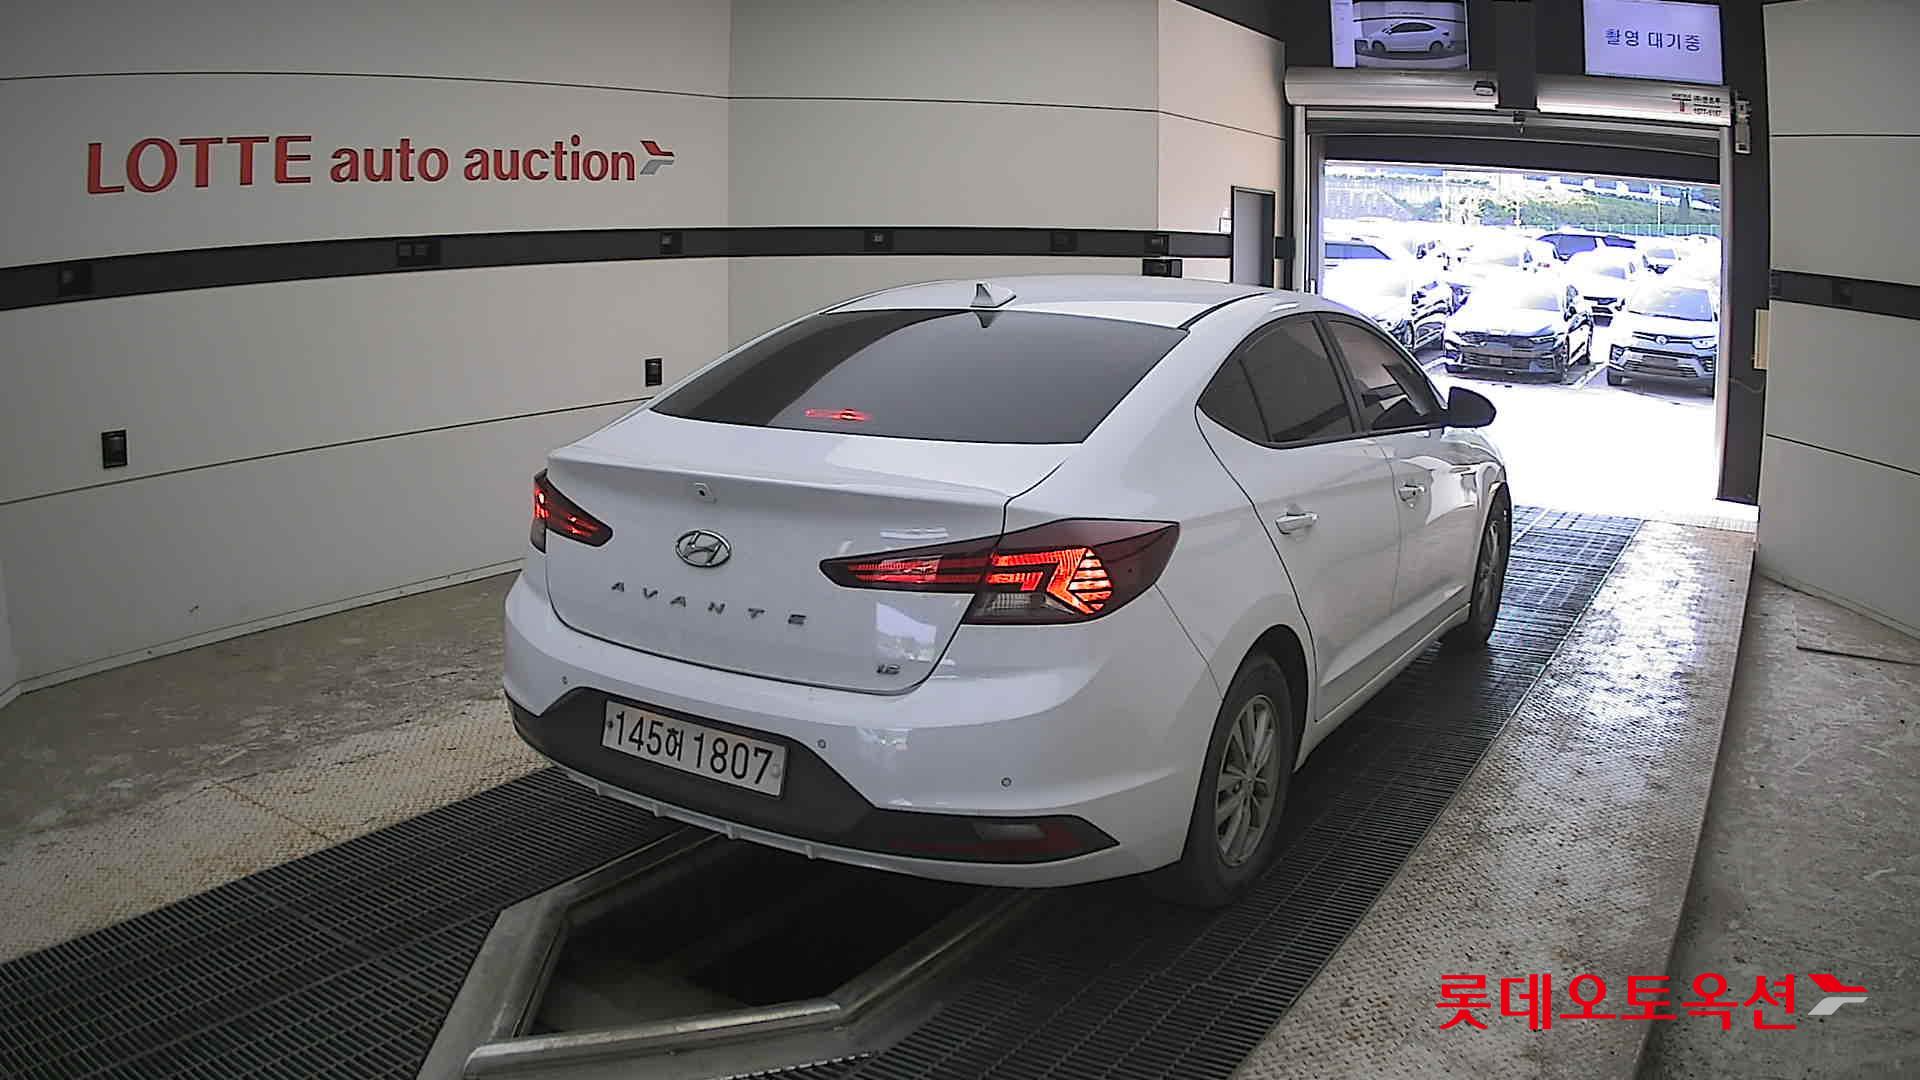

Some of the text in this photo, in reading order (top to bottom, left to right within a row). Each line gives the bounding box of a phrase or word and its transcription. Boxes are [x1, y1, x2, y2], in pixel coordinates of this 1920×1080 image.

[87, 135, 638, 195] LOTTE auto auction
[611, 582, 806, 625] AVANTE
[615, 711, 773, 785] 145허 1807
